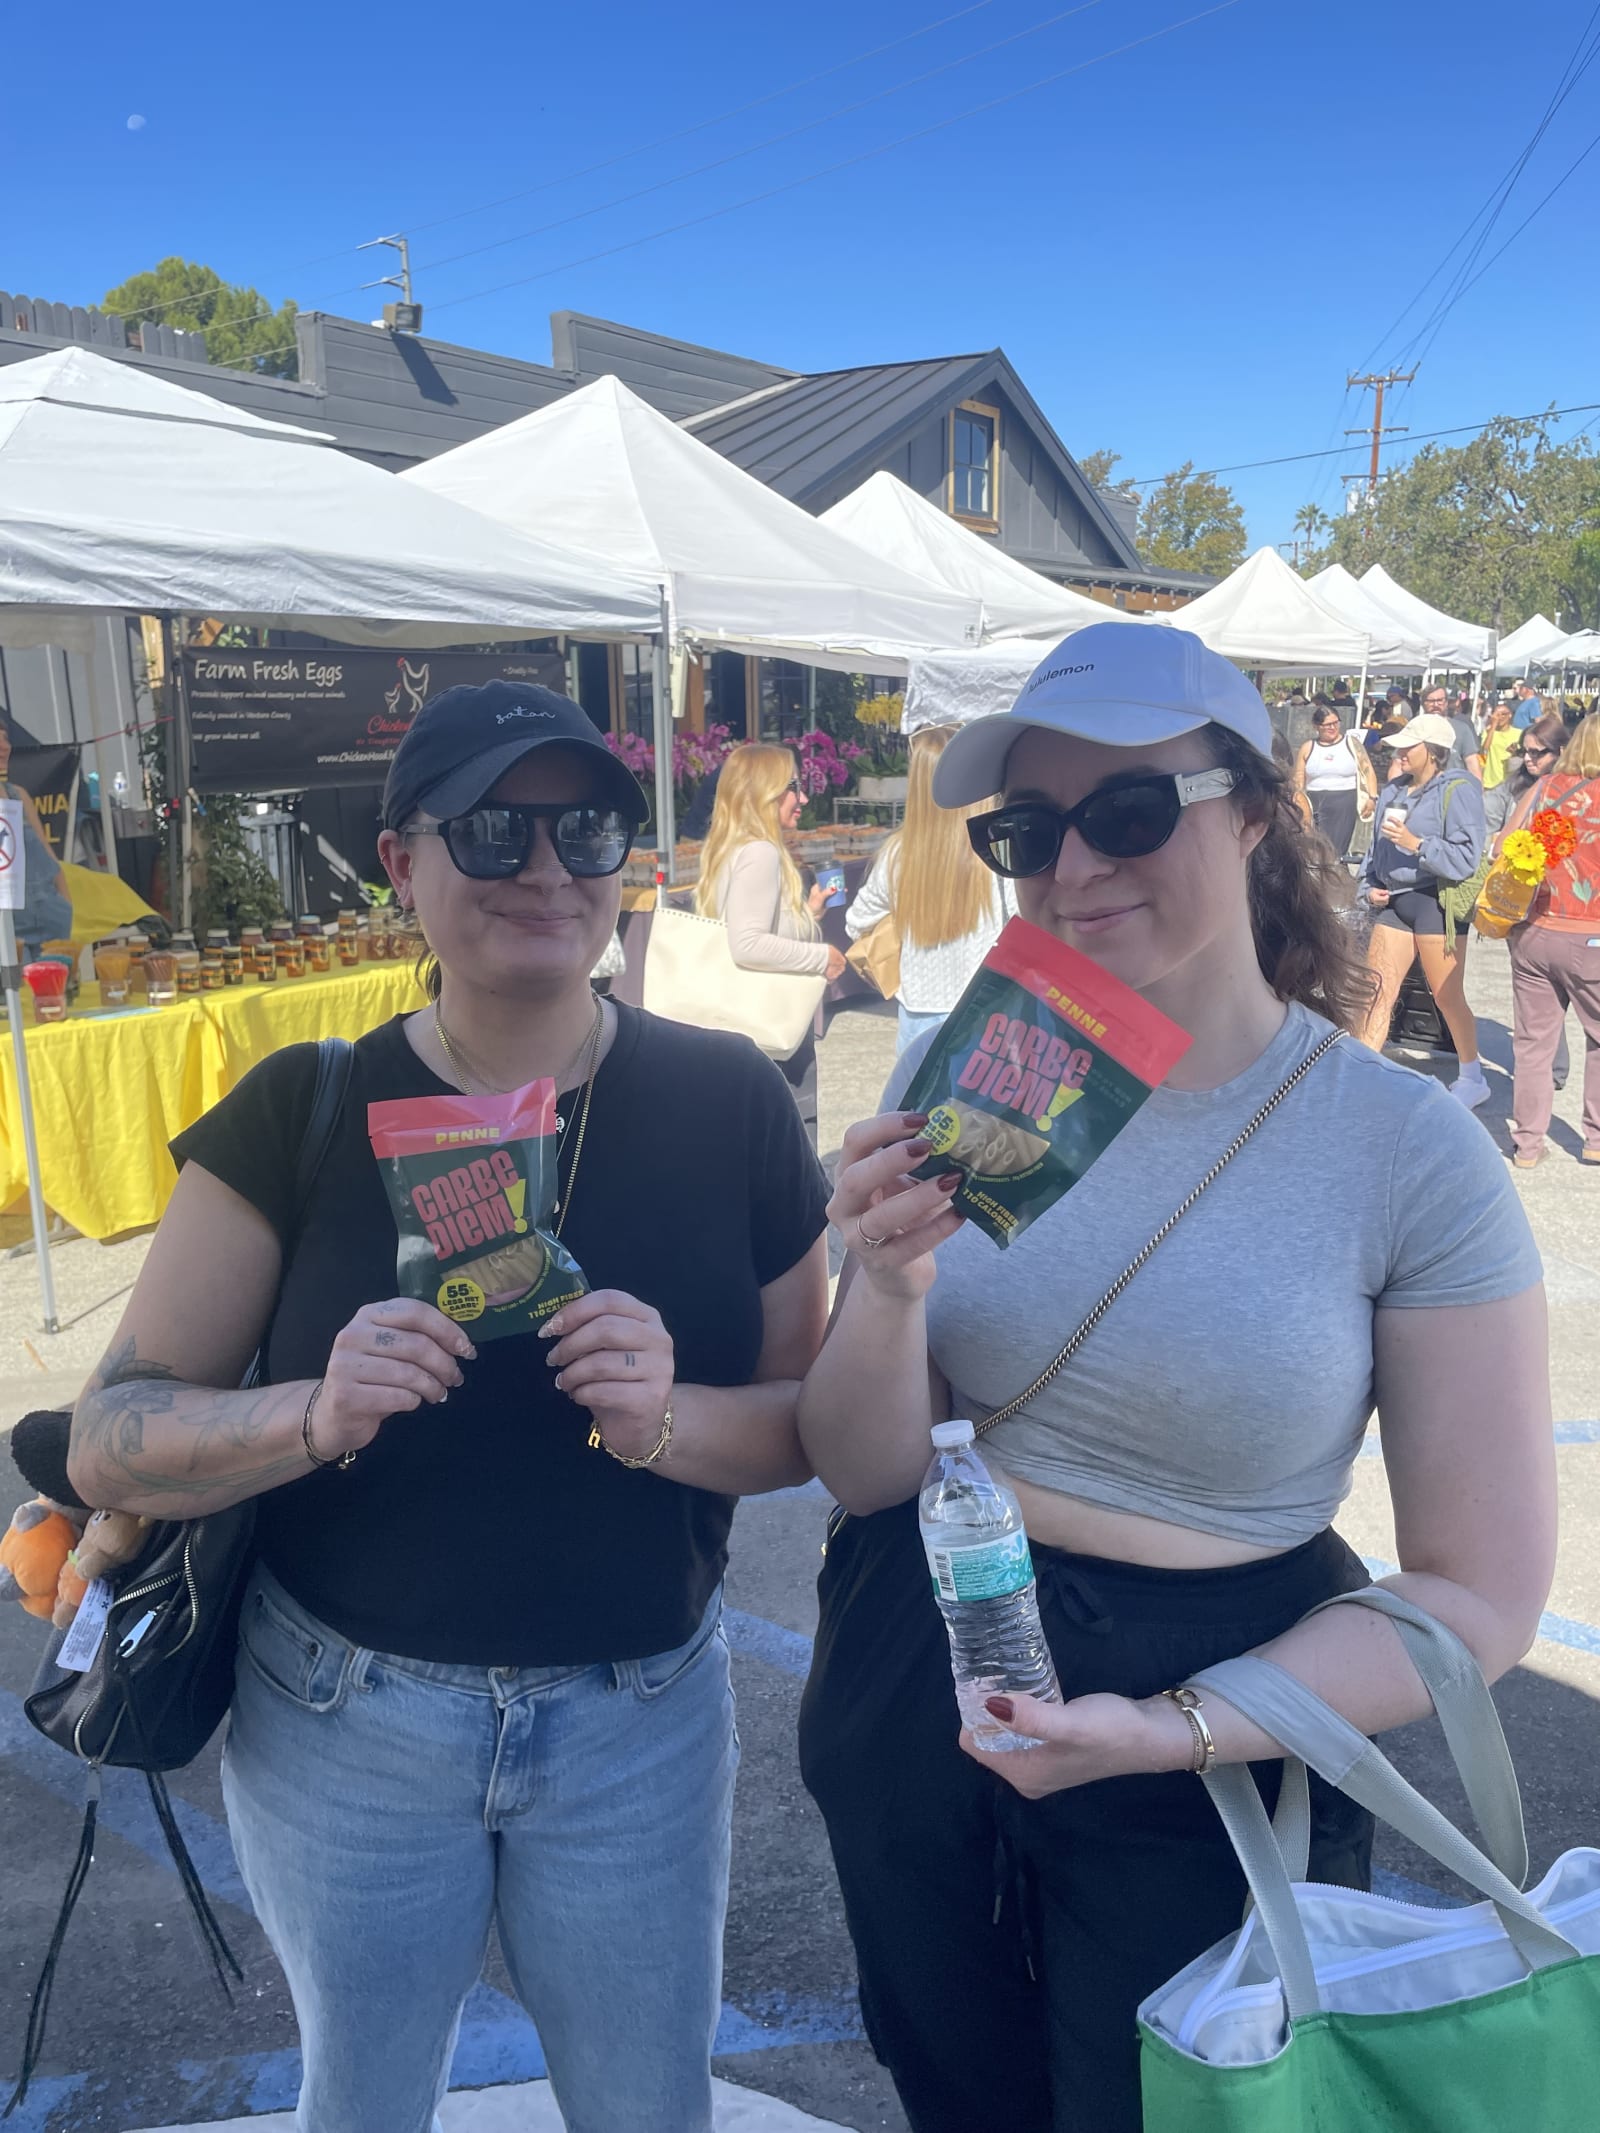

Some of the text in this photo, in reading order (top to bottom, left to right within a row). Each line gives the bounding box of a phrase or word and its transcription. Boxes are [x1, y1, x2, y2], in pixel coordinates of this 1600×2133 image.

[195, 659, 343, 687] Farm Fresh Eggs
[1027, 664, 1095, 694] lululemon
[496, 706, 556, 724] satan
[1045, 986, 1108, 1039] PENNE
[434, 1127, 500, 1145] PENNE
[962, 1188, 979, 1204] 110
[977, 1201, 1014, 1234] CALORIES
[976, 1191, 1019, 1228] HIGH FIBER
[442, 1295, 480, 1307] LESS NET
[537, 1289, 584, 1309] HIGH FIBER
[528, 1309, 546, 1319] 110
